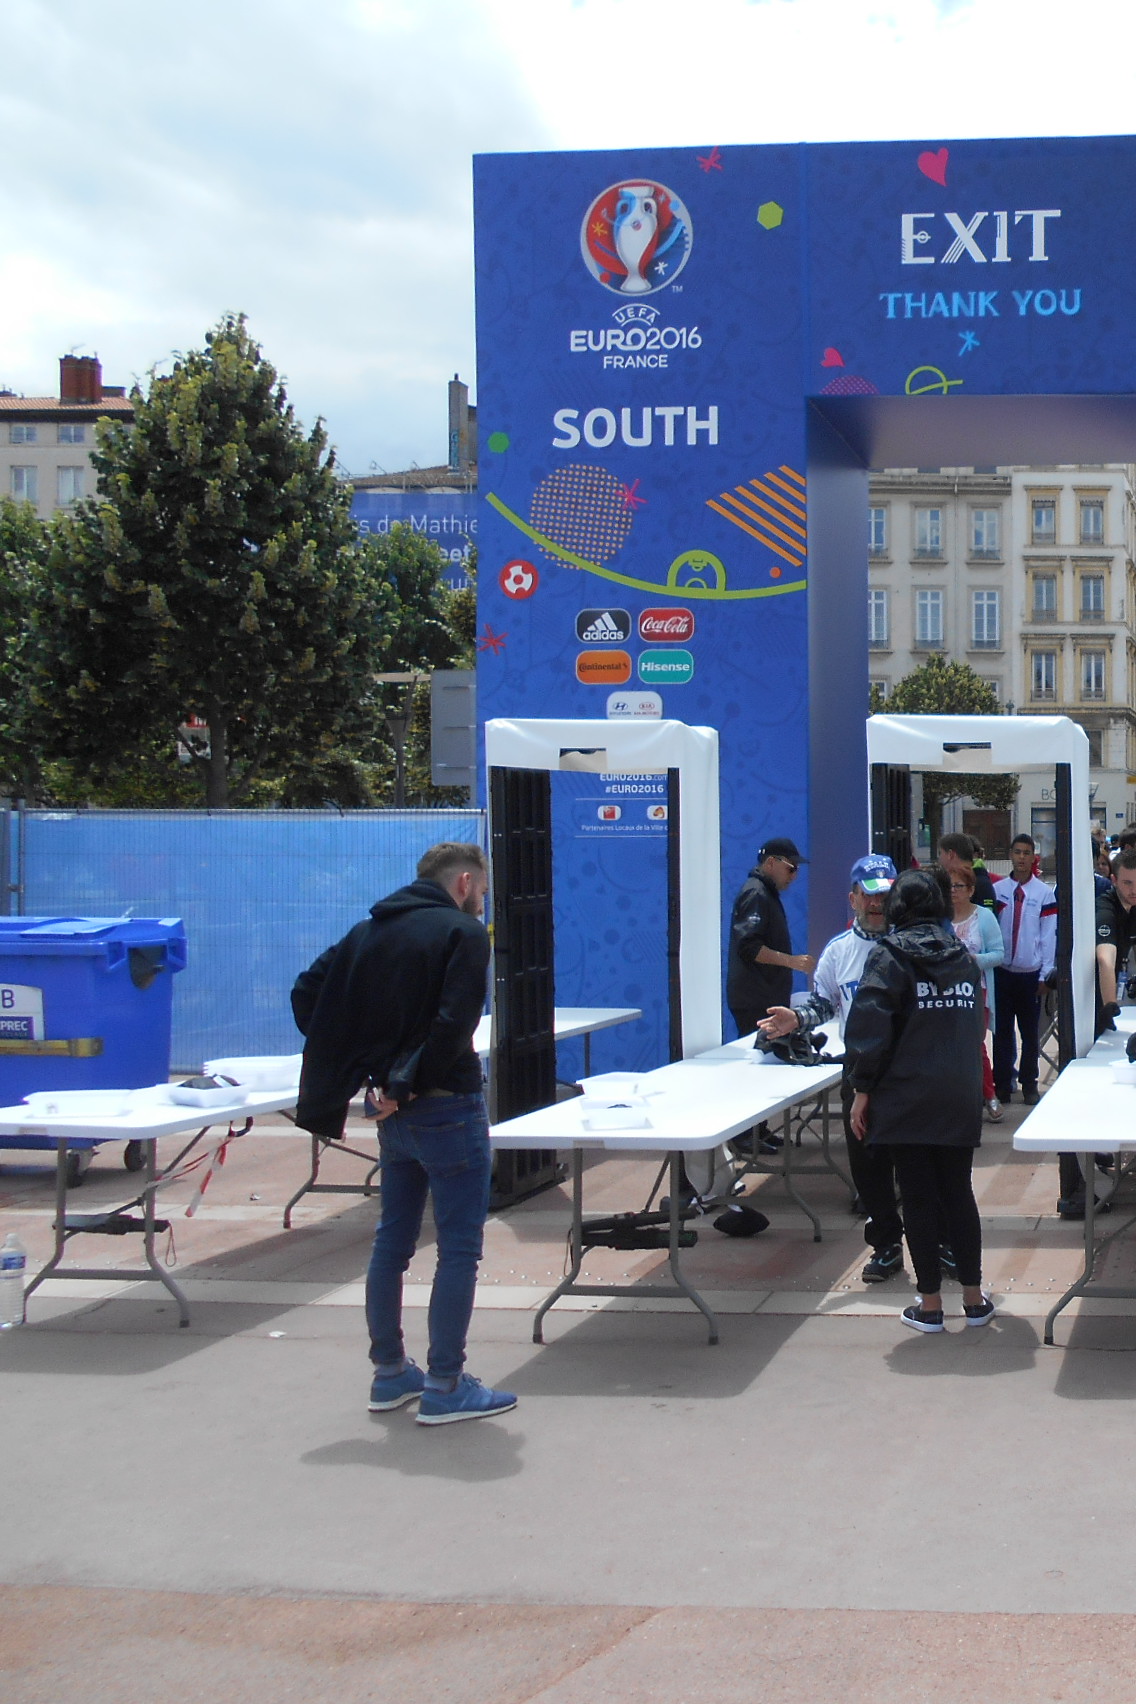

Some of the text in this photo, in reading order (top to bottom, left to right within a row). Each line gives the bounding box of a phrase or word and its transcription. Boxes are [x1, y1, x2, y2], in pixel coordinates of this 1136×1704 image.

[901, 209, 1061, 265] EXIT
[880, 288, 1082, 319] THANK YOU
[615, 307, 656, 323] UEFA
[570, 326, 702, 352] EURO2016
[603, 354, 668, 369] FRANCE
[552, 406, 719, 449] SOUTH
[583, 630, 624, 640] adidas
[578, 662, 622, 672] Continental
[641, 662, 690, 671] Hisense
[605, 784, 664, 793] #EURO2016
[919, 999, 974, 1009] SECURIT
